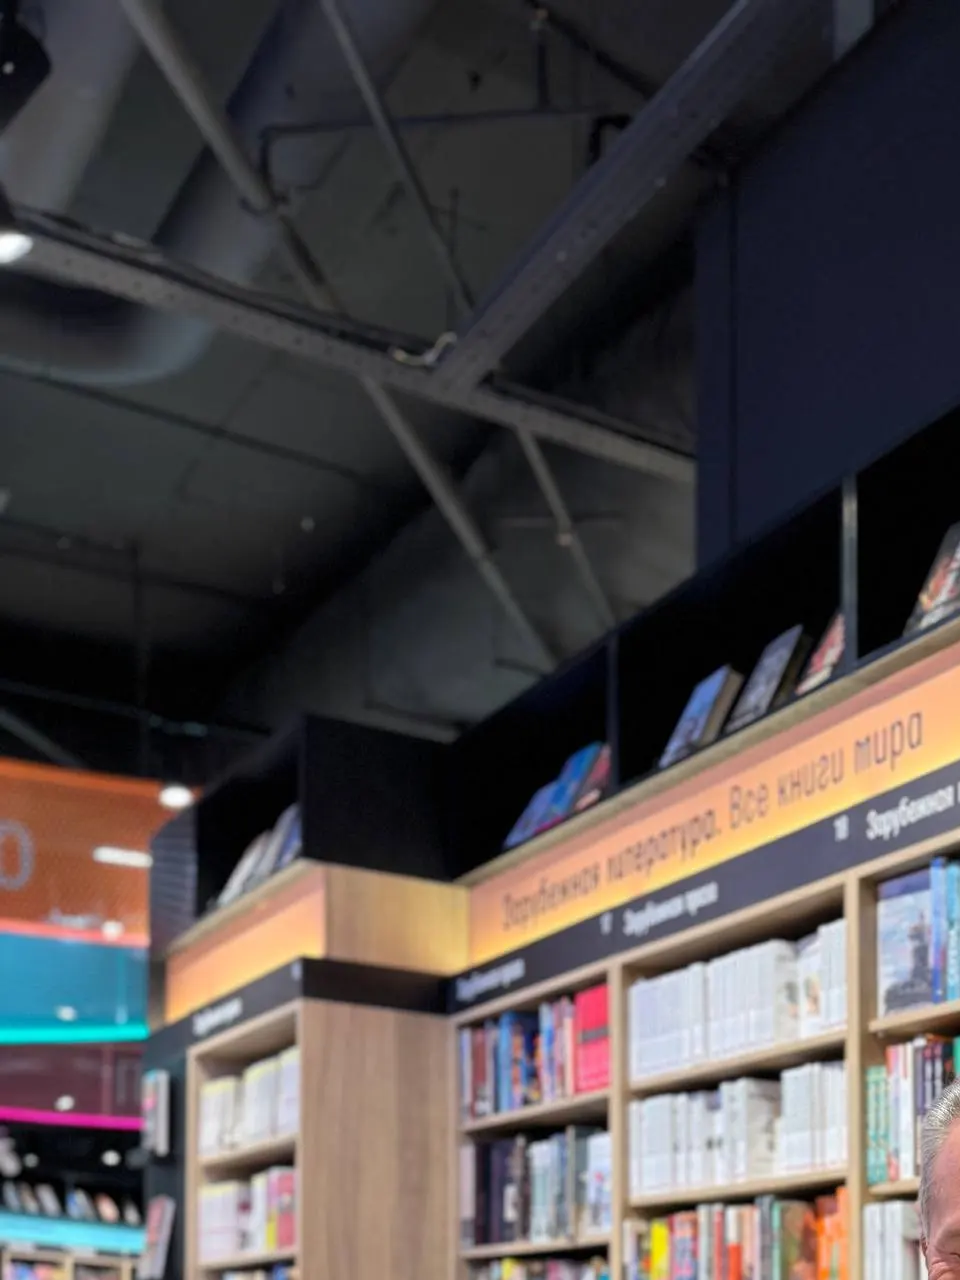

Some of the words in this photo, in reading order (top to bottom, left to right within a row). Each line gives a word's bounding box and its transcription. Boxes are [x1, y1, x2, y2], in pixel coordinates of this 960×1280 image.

[729, 785, 768, 830] Все
[778, 749, 845, 806] книги
[853, 711, 922, 775] мира
